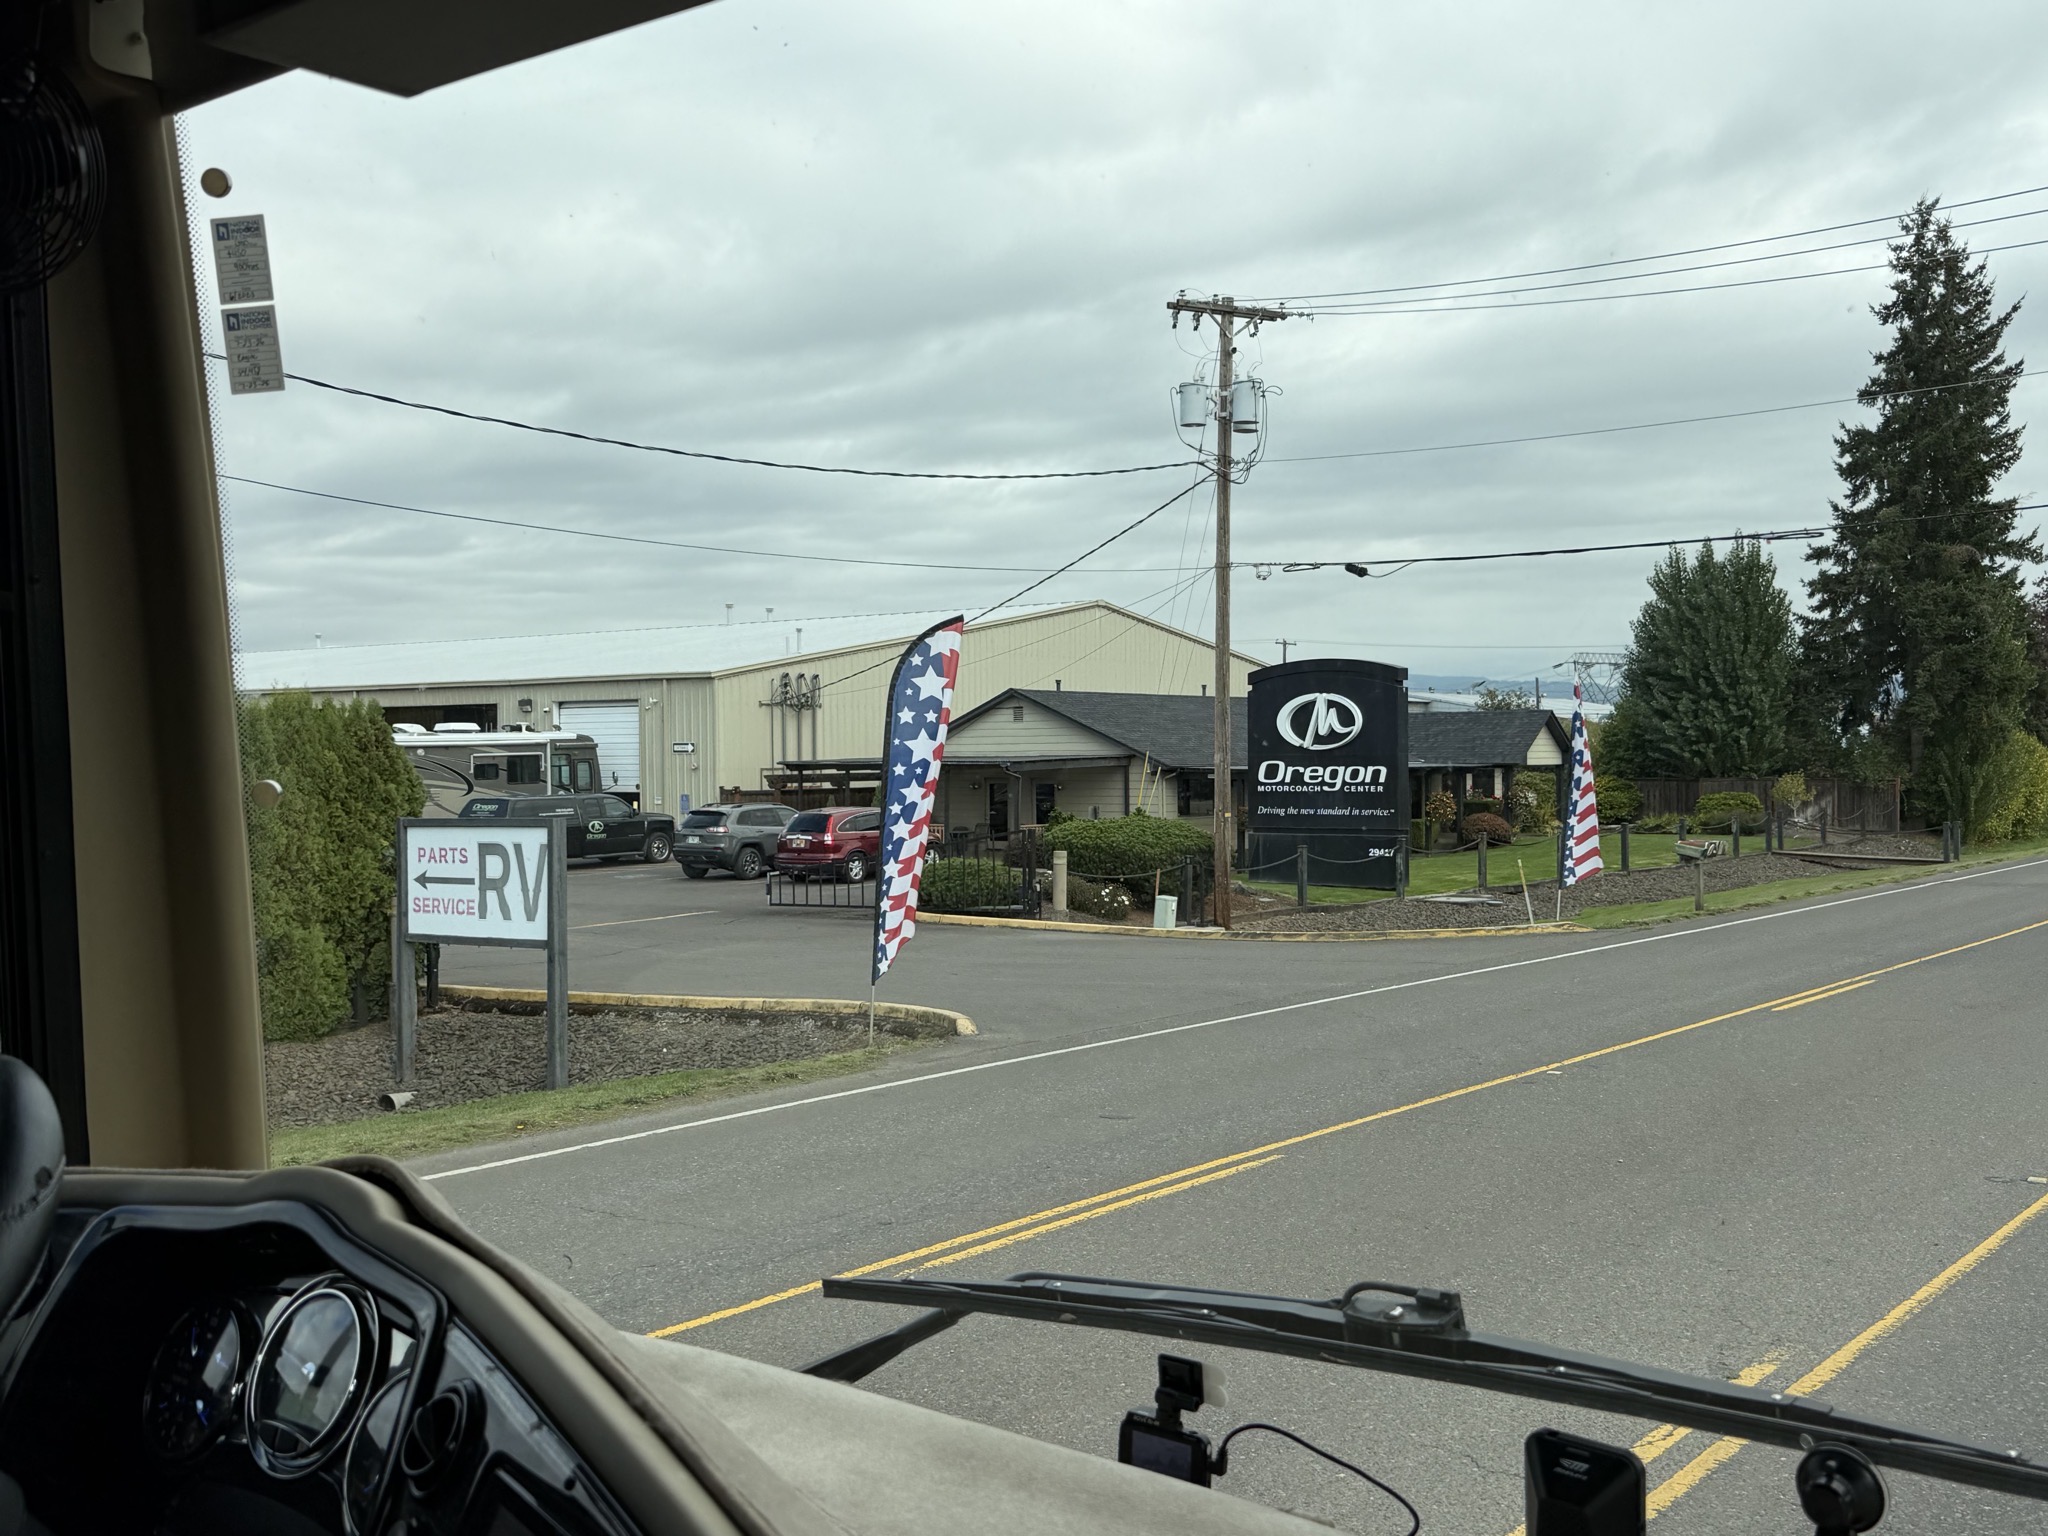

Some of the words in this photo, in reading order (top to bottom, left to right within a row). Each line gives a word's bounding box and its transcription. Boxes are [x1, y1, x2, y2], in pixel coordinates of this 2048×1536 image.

[230, 226, 260, 234] INDOOR
[240, 310, 270, 318] NATIONAL
[241, 316, 270, 324] INDOOR
[1257, 760, 1388, 792] Oregon
[1344, 785, 1384, 793] CENTER
[1257, 806, 1286, 816] Driving
[1287, 806, 1298, 815] the
[1317, 806, 1350, 816] standard
[1352, 807, 1359, 816] in
[417, 847, 469, 864] PARTS
[477, 841, 548, 922] RV
[412, 897, 476, 916] SERVICE
